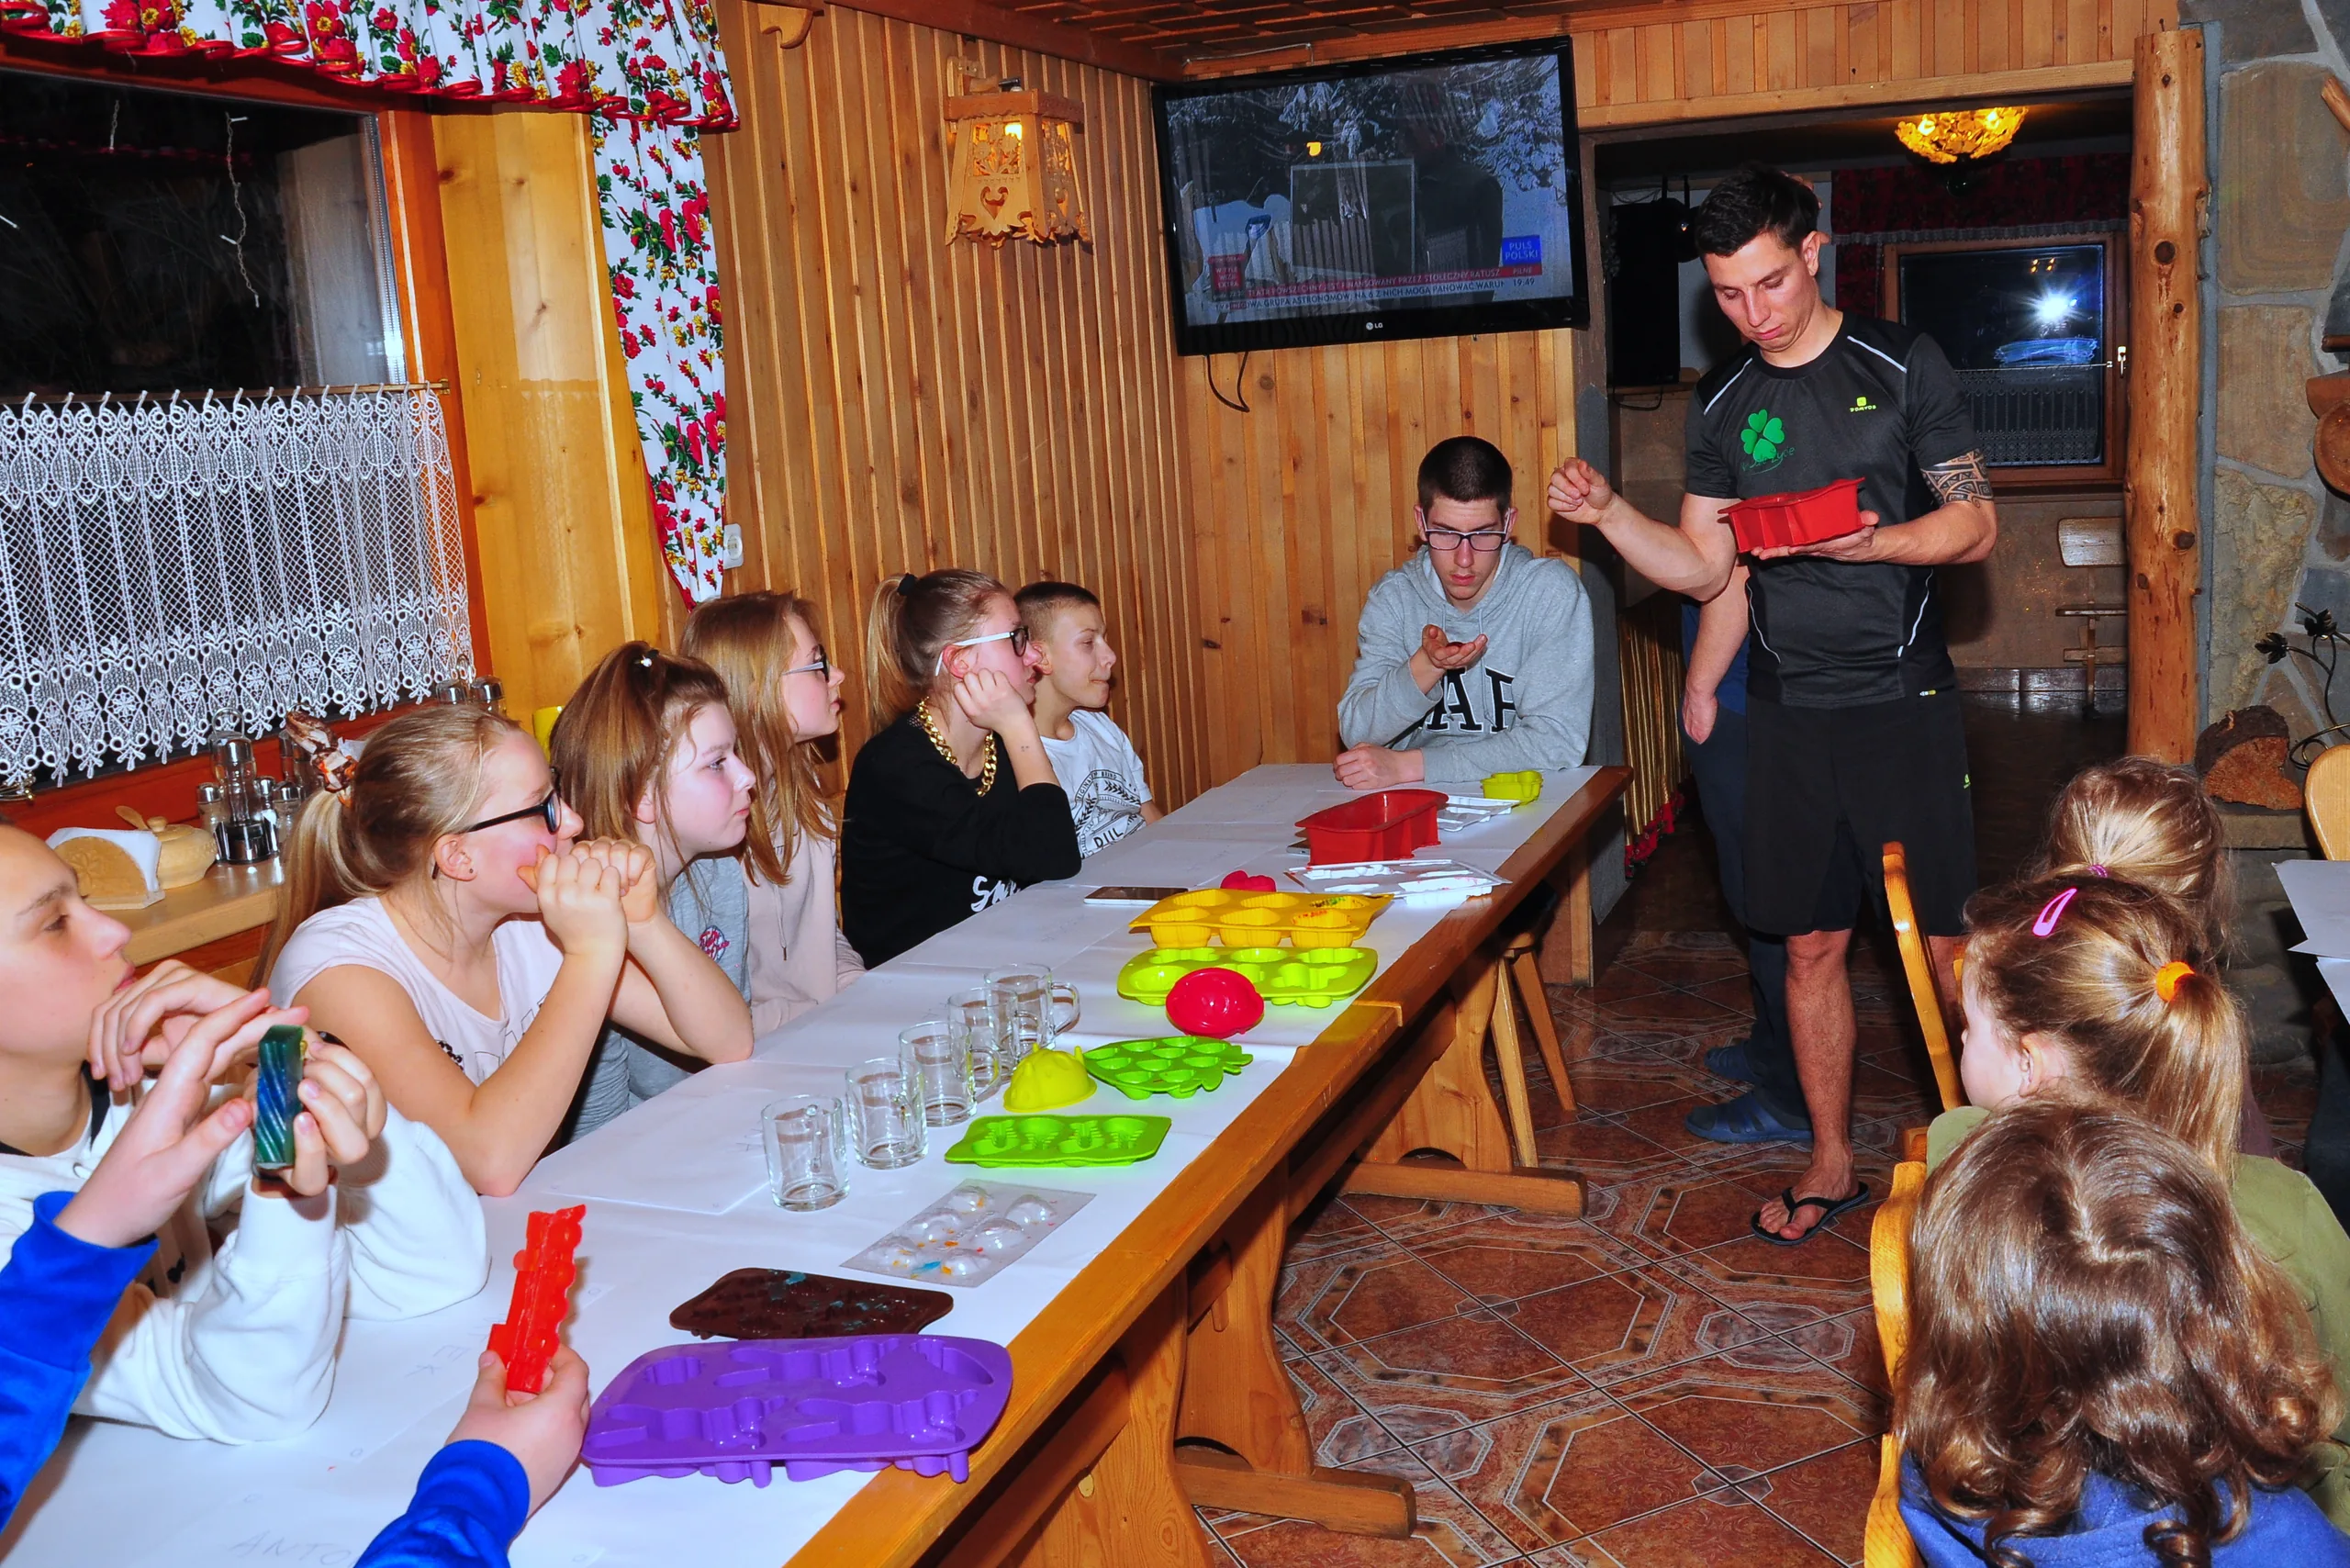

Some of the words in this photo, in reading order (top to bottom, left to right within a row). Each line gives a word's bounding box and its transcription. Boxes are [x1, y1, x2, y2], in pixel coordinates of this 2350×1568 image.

[1509, 241, 1532, 251] PULS
[1505, 250, 1538, 260] POLSKI
[1398, 274, 1422, 285] PRZEZ
[1513, 277, 1535, 286] 19:49
[1263, 297, 1290, 307] GRUPA
[1356, 290, 1367, 299] NA
[1383, 287, 1404, 297] NICH
